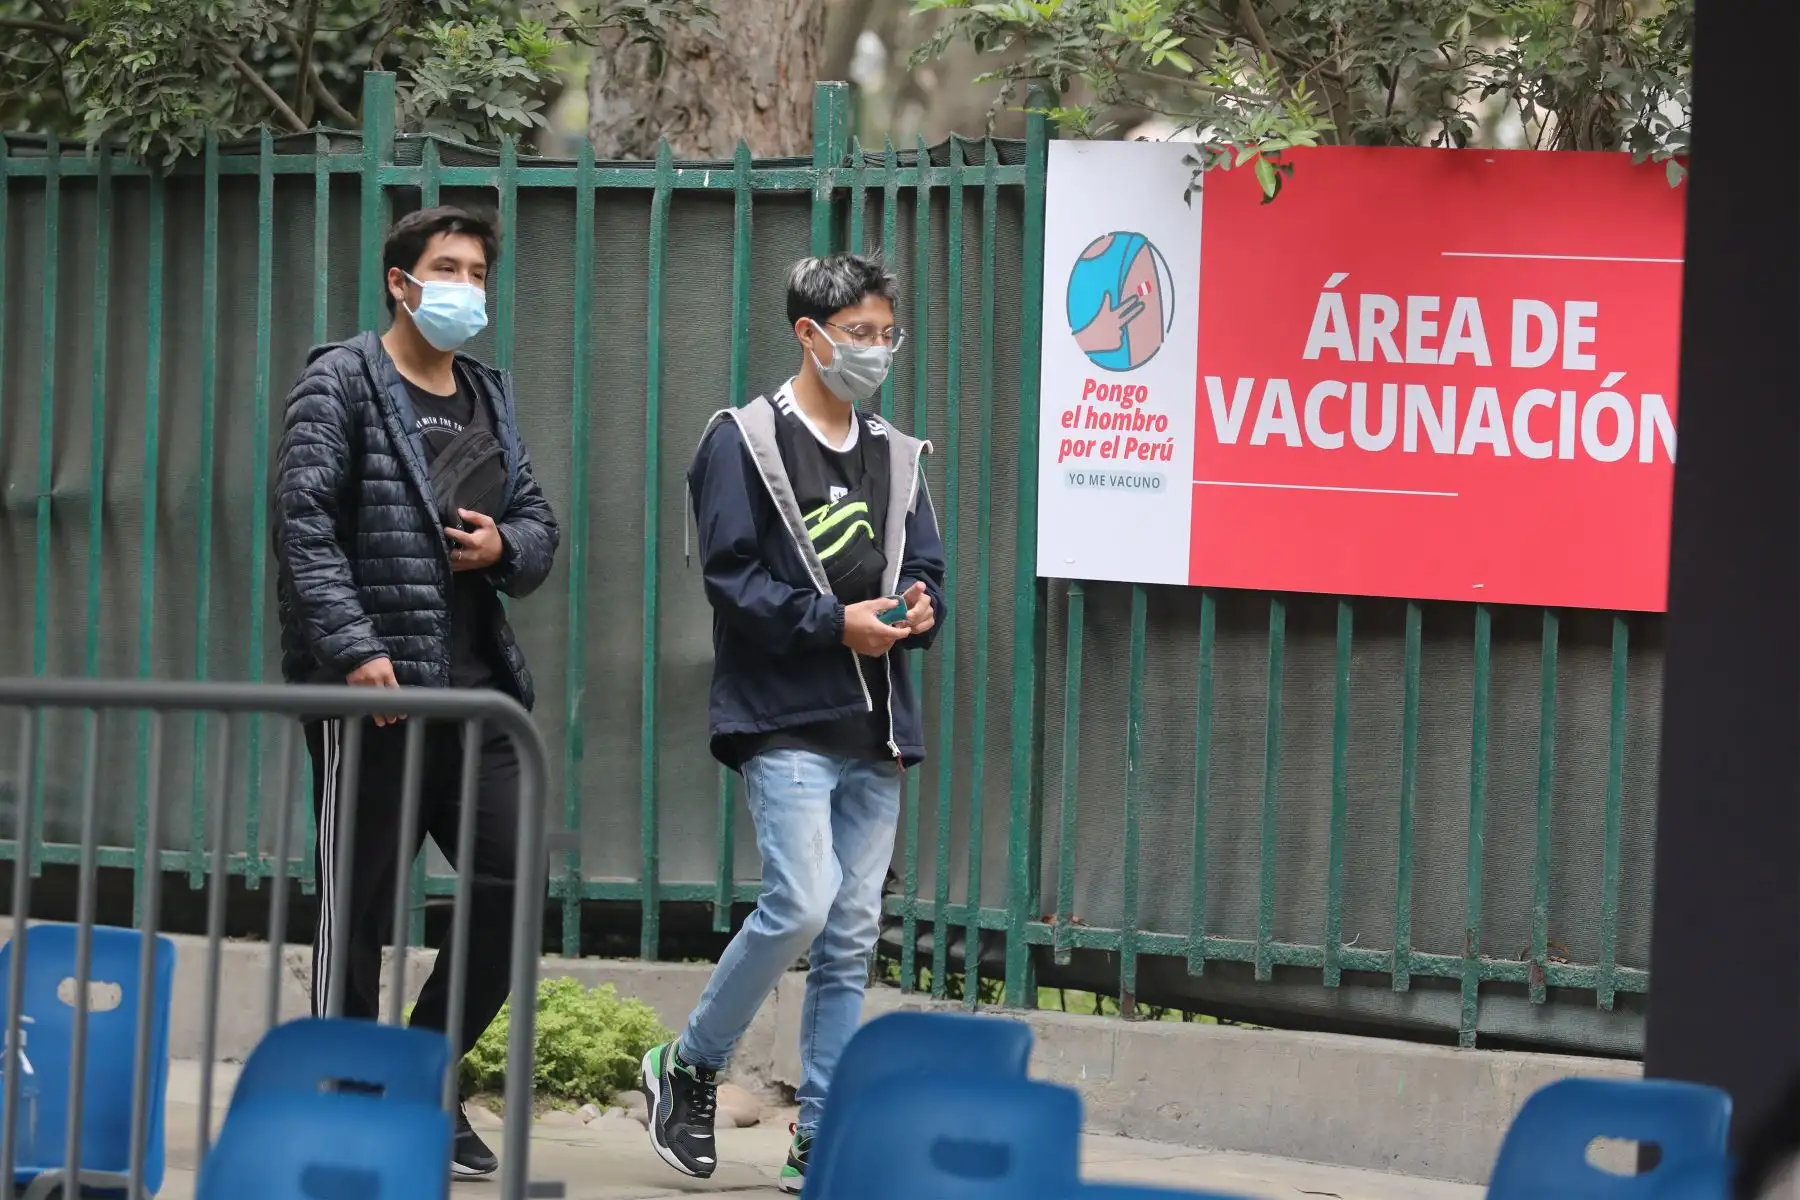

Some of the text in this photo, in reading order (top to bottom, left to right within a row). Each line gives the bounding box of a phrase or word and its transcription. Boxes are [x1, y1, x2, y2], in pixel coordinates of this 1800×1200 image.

[1302, 272, 1598, 371] ÁREA DE
[1082, 378, 1148, 409] Pongo
[1061, 405, 1168, 432] el hombro
[1204, 372, 1677, 465] VACUNACIÓN
[1058, 435, 1174, 464] por el Perú
[1069, 473, 1161, 489] YO ME VACUNO
